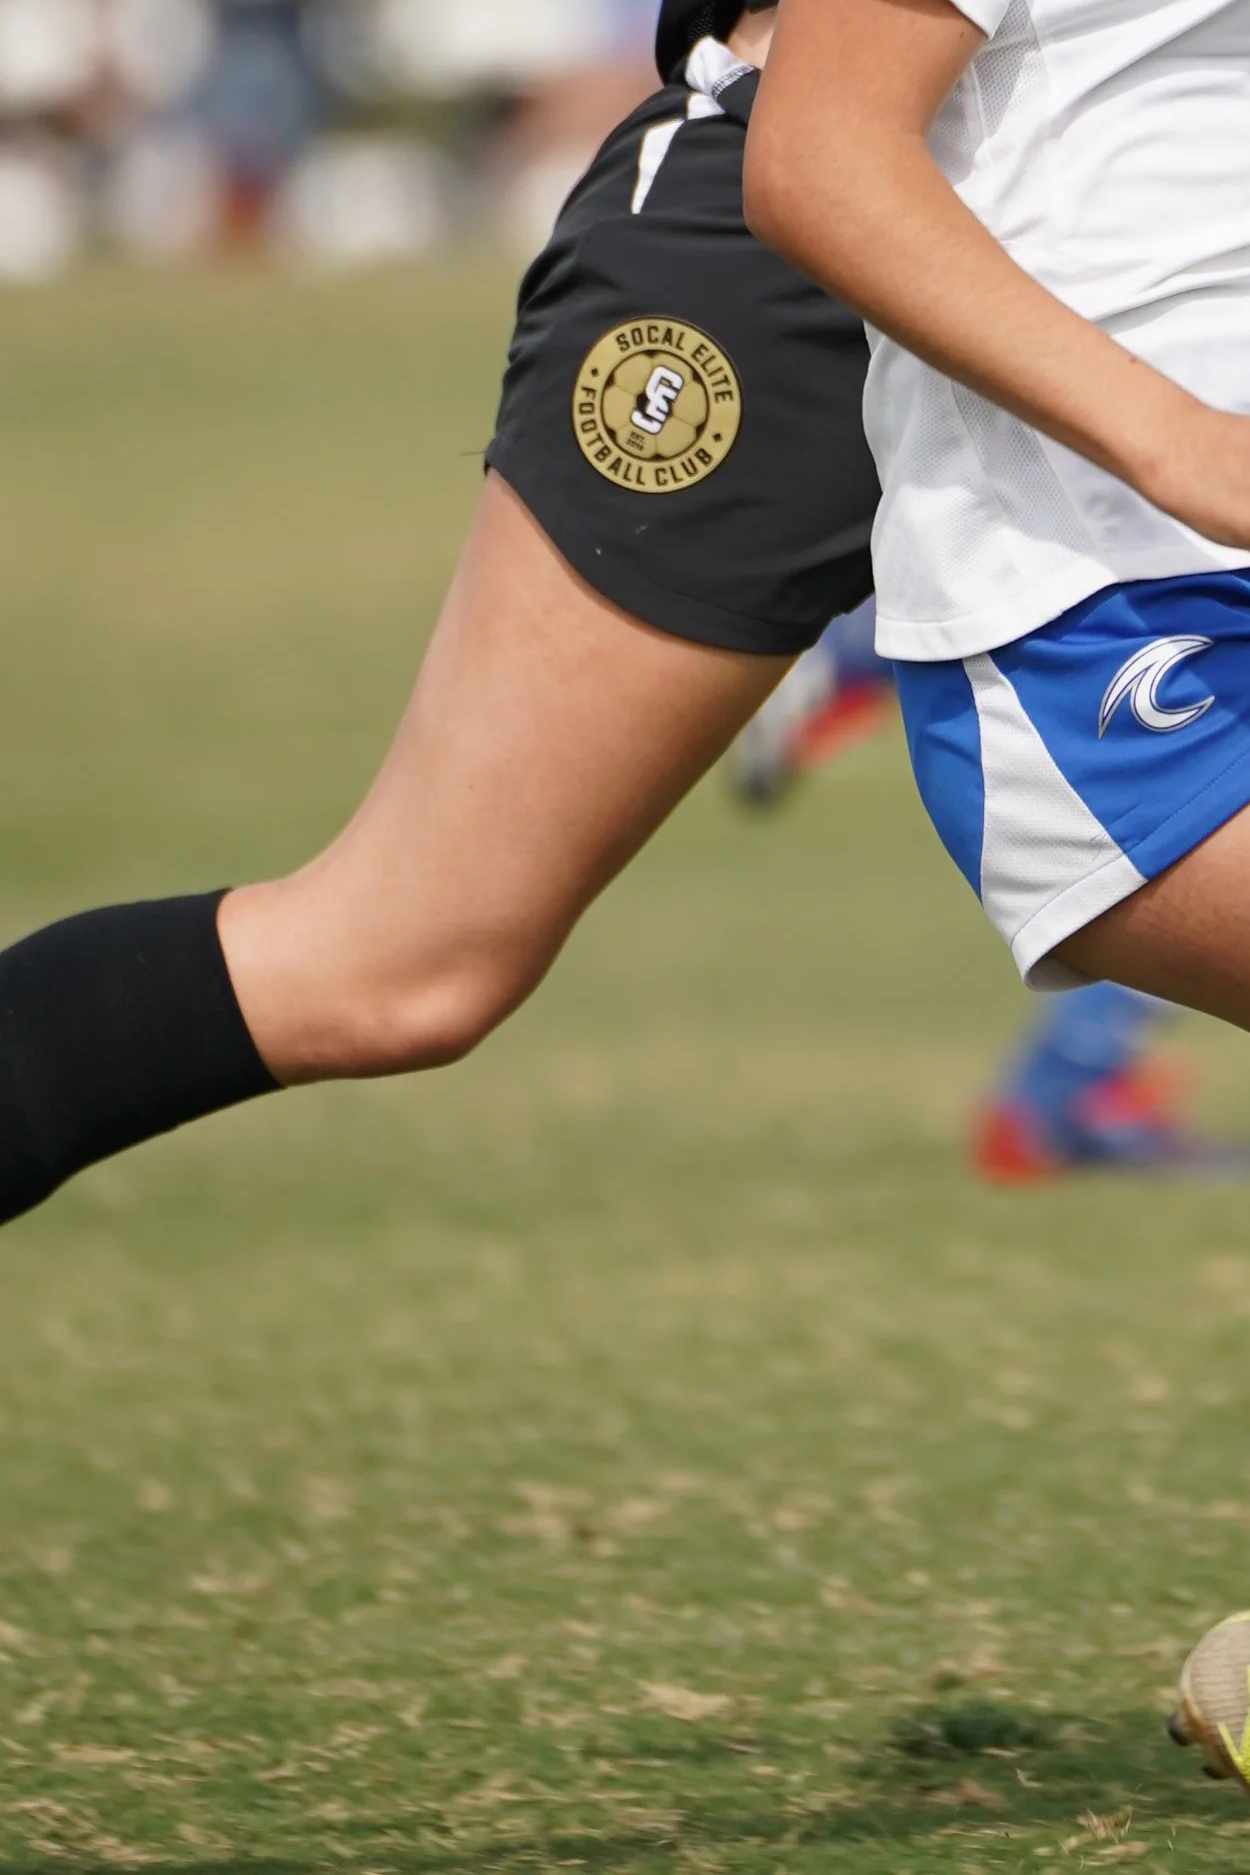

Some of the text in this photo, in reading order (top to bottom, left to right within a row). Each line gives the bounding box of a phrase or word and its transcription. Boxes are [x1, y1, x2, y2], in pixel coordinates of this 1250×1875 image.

[615, 325, 734, 404] SOCAL ELITE
[579, 386, 714, 486] FOOTBALL CLUB
